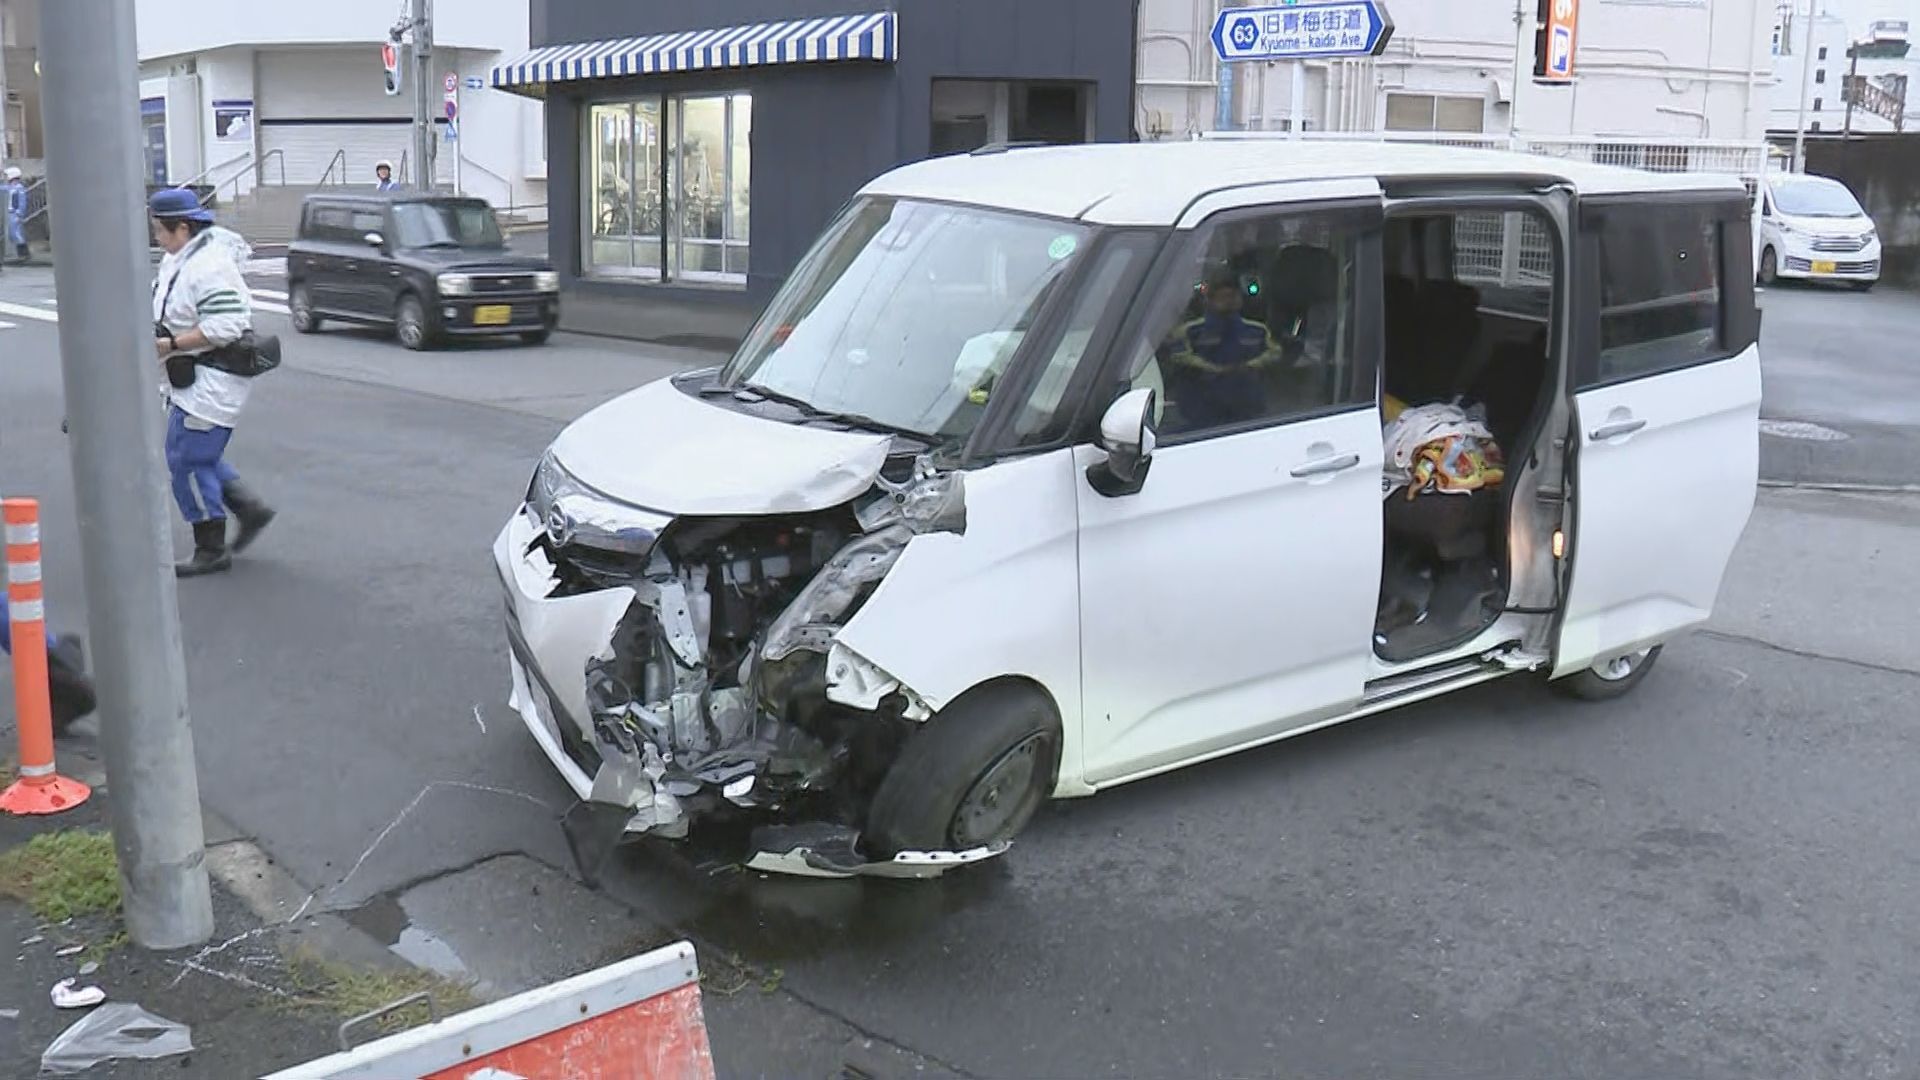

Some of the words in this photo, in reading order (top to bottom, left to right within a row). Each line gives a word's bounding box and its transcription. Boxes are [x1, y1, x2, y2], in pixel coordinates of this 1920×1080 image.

[1262, 9, 1361, 34] 旧青梅街道
[1234, 25, 1254, 44] 63
